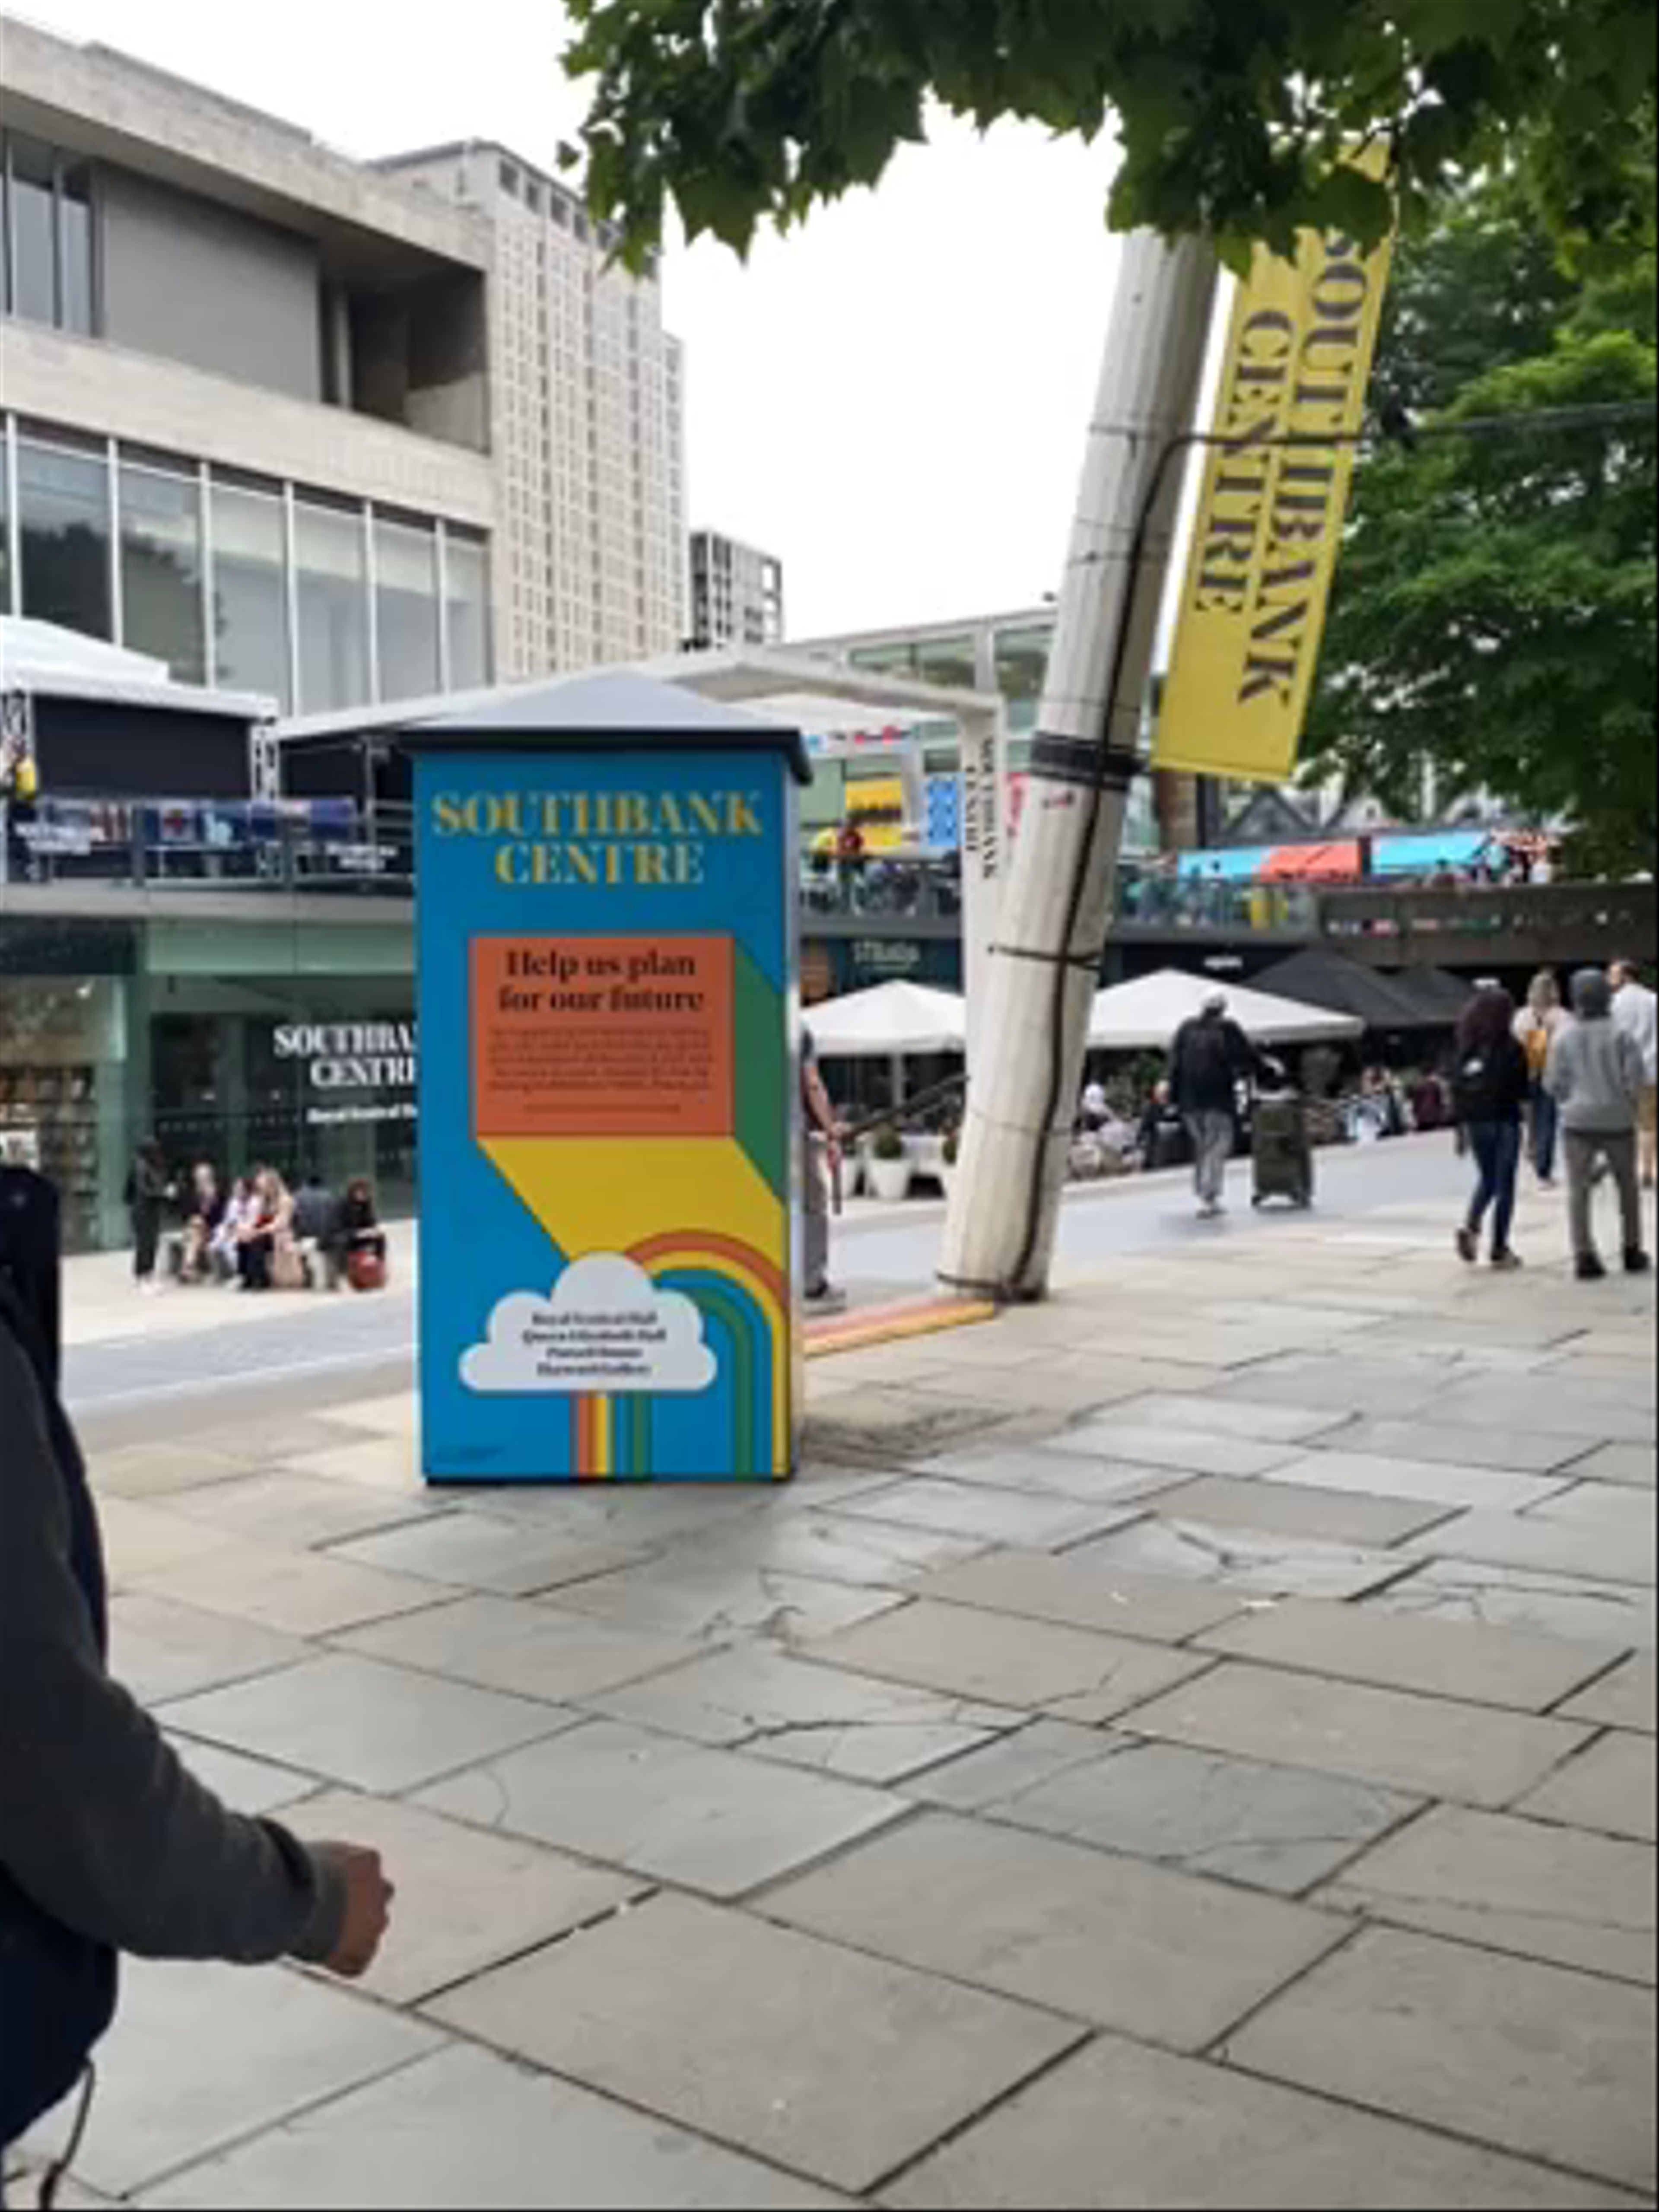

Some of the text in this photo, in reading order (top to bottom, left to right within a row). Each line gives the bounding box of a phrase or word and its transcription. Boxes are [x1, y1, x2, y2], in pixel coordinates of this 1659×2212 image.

[1195, 309, 1292, 612] CENTRE
[432, 790, 763, 837] SOUTHBANK
[495, 842, 705, 885] CENTRE
[506, 949, 696, 984] Help us plan
[499, 984, 705, 1012] for our future
